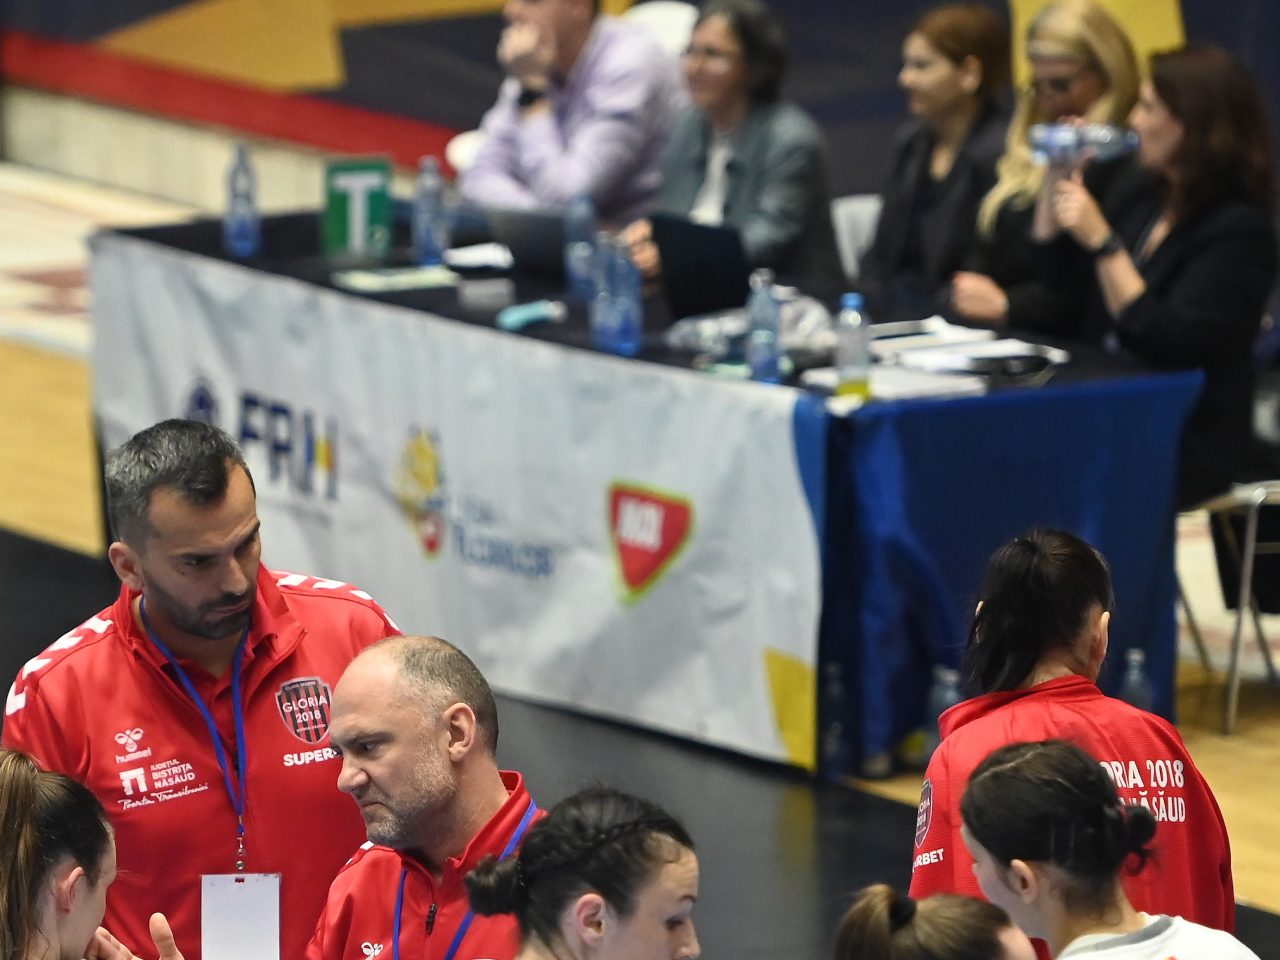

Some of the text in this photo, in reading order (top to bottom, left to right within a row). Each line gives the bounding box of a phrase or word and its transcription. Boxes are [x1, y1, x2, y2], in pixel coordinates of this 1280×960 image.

[282, 695, 328, 712] GLORIA
[296, 710, 322, 723] 2018
[115, 747, 153, 764] hummel
[1145, 760, 1185, 788] 2018
[912, 848, 945, 873] RBET
